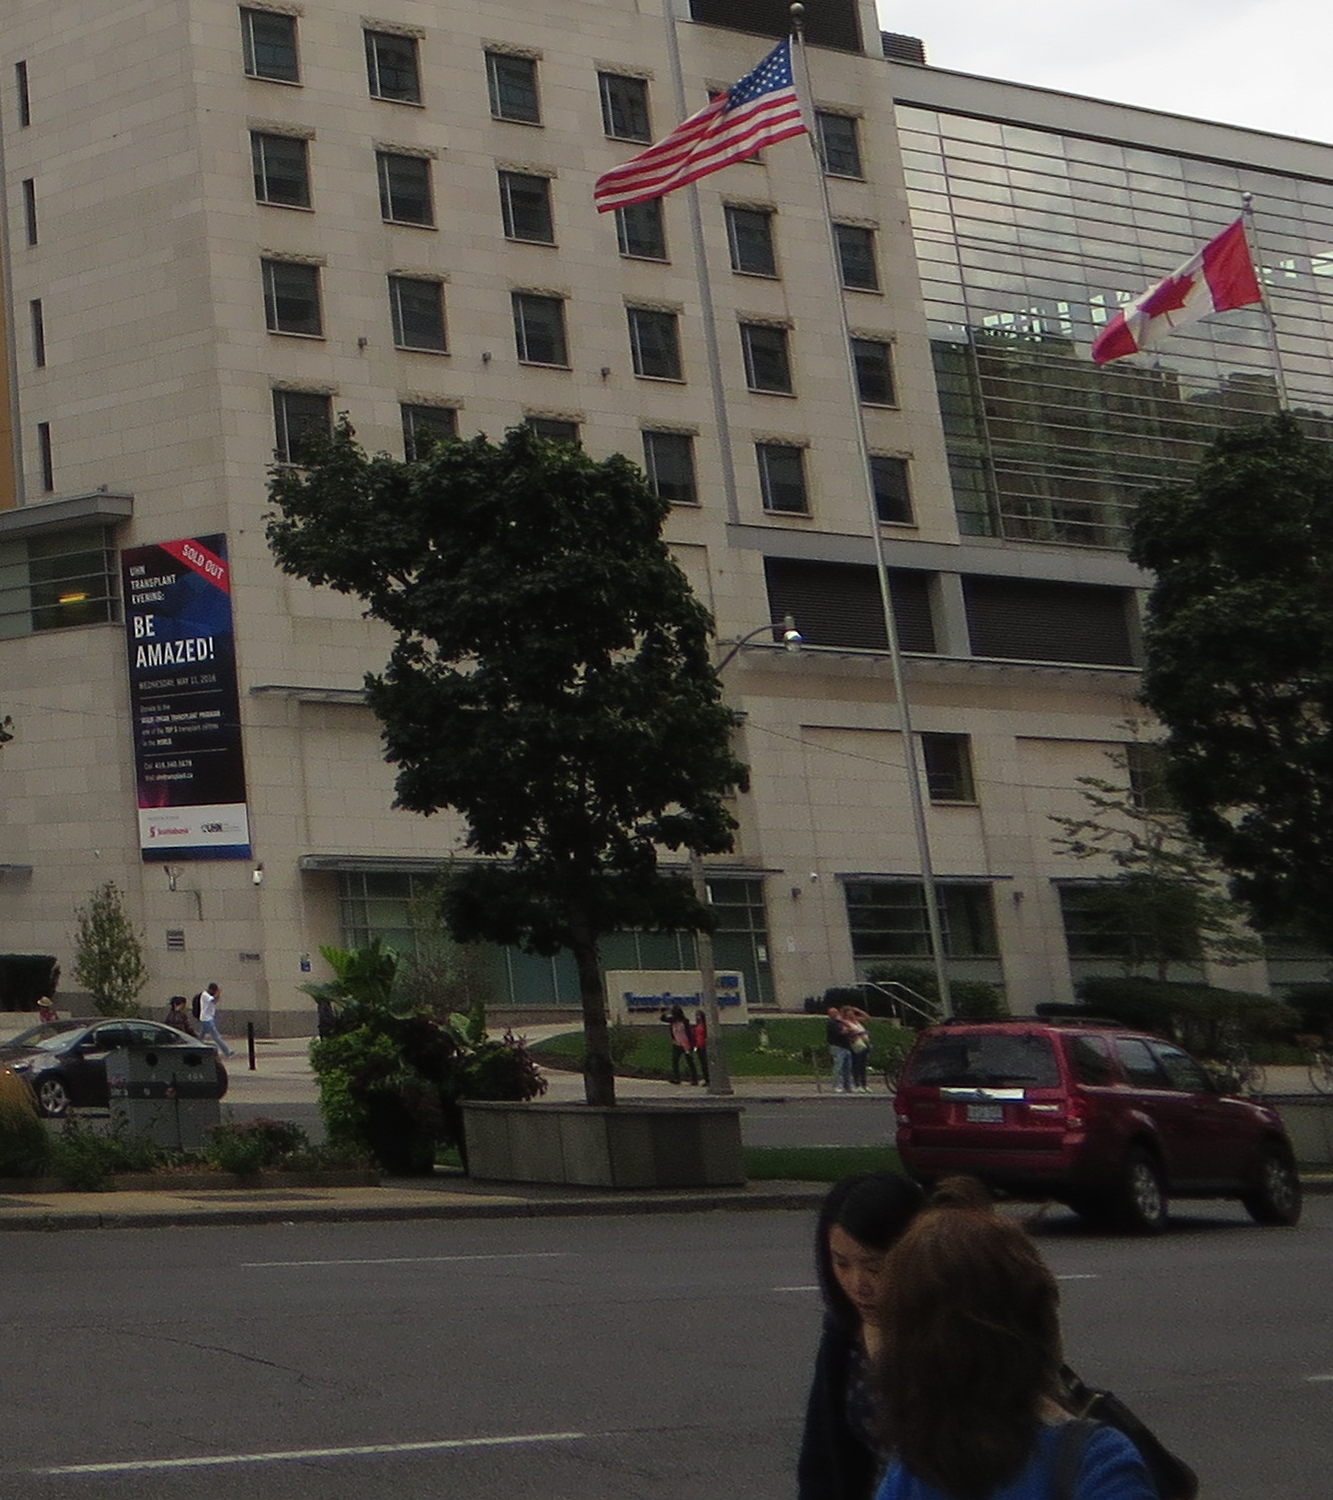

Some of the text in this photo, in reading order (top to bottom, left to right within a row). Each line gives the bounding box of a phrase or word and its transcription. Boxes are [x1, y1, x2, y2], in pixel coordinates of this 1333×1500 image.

[182, 544, 224, 579] SOLD OUT
[133, 614, 156, 638] BE
[136, 636, 215, 668] AMAZED!
